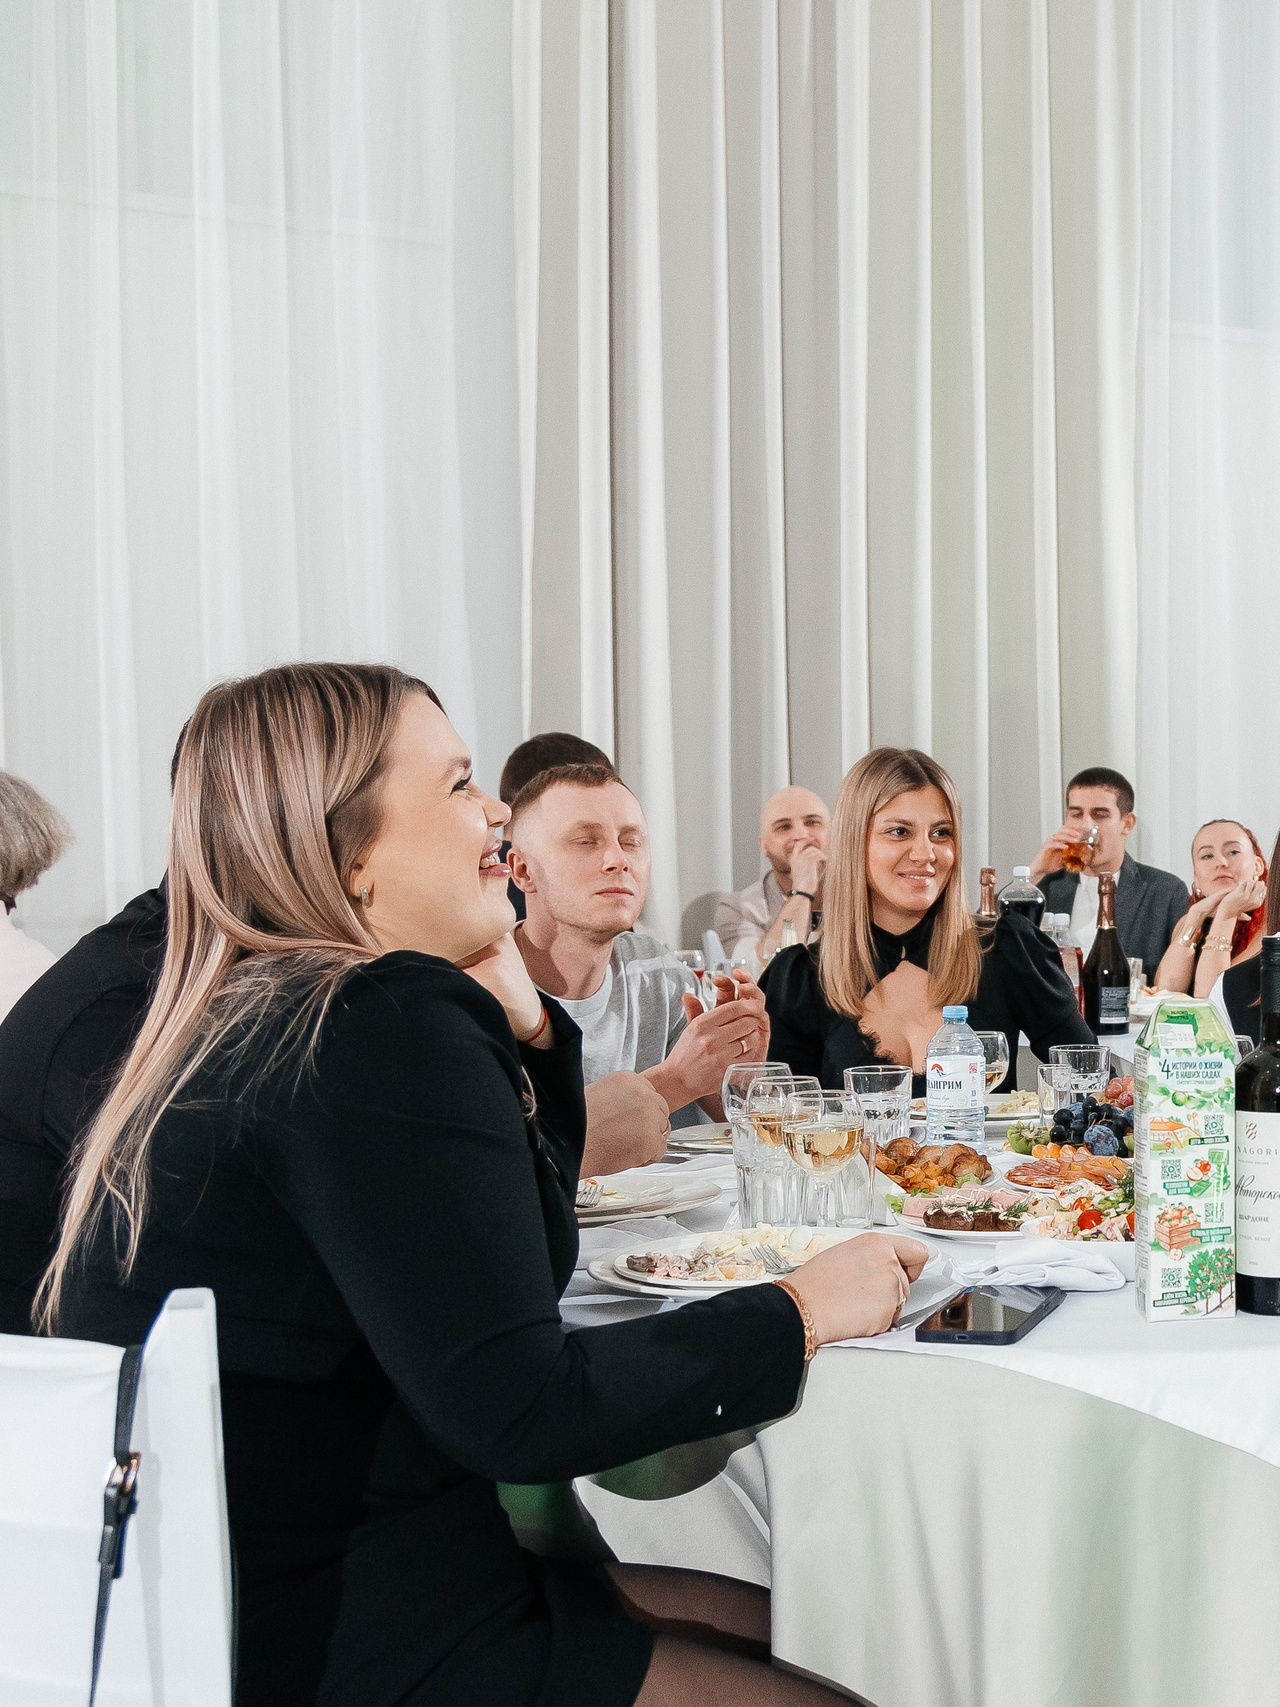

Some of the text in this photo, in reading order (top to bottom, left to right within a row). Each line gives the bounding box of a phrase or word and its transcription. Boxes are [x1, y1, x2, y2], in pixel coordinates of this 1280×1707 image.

[1161, 1058, 1171, 1080] 4
[1172, 1061, 1197, 1070] ИСТОРИИ
[1204, 1061, 1223, 1069] ЖИЗНИ
[1175, 1070, 1221, 1079] В НАШИХ САДАХ
[1238, 1213, 1270, 1223] ШАРДОНЕ
